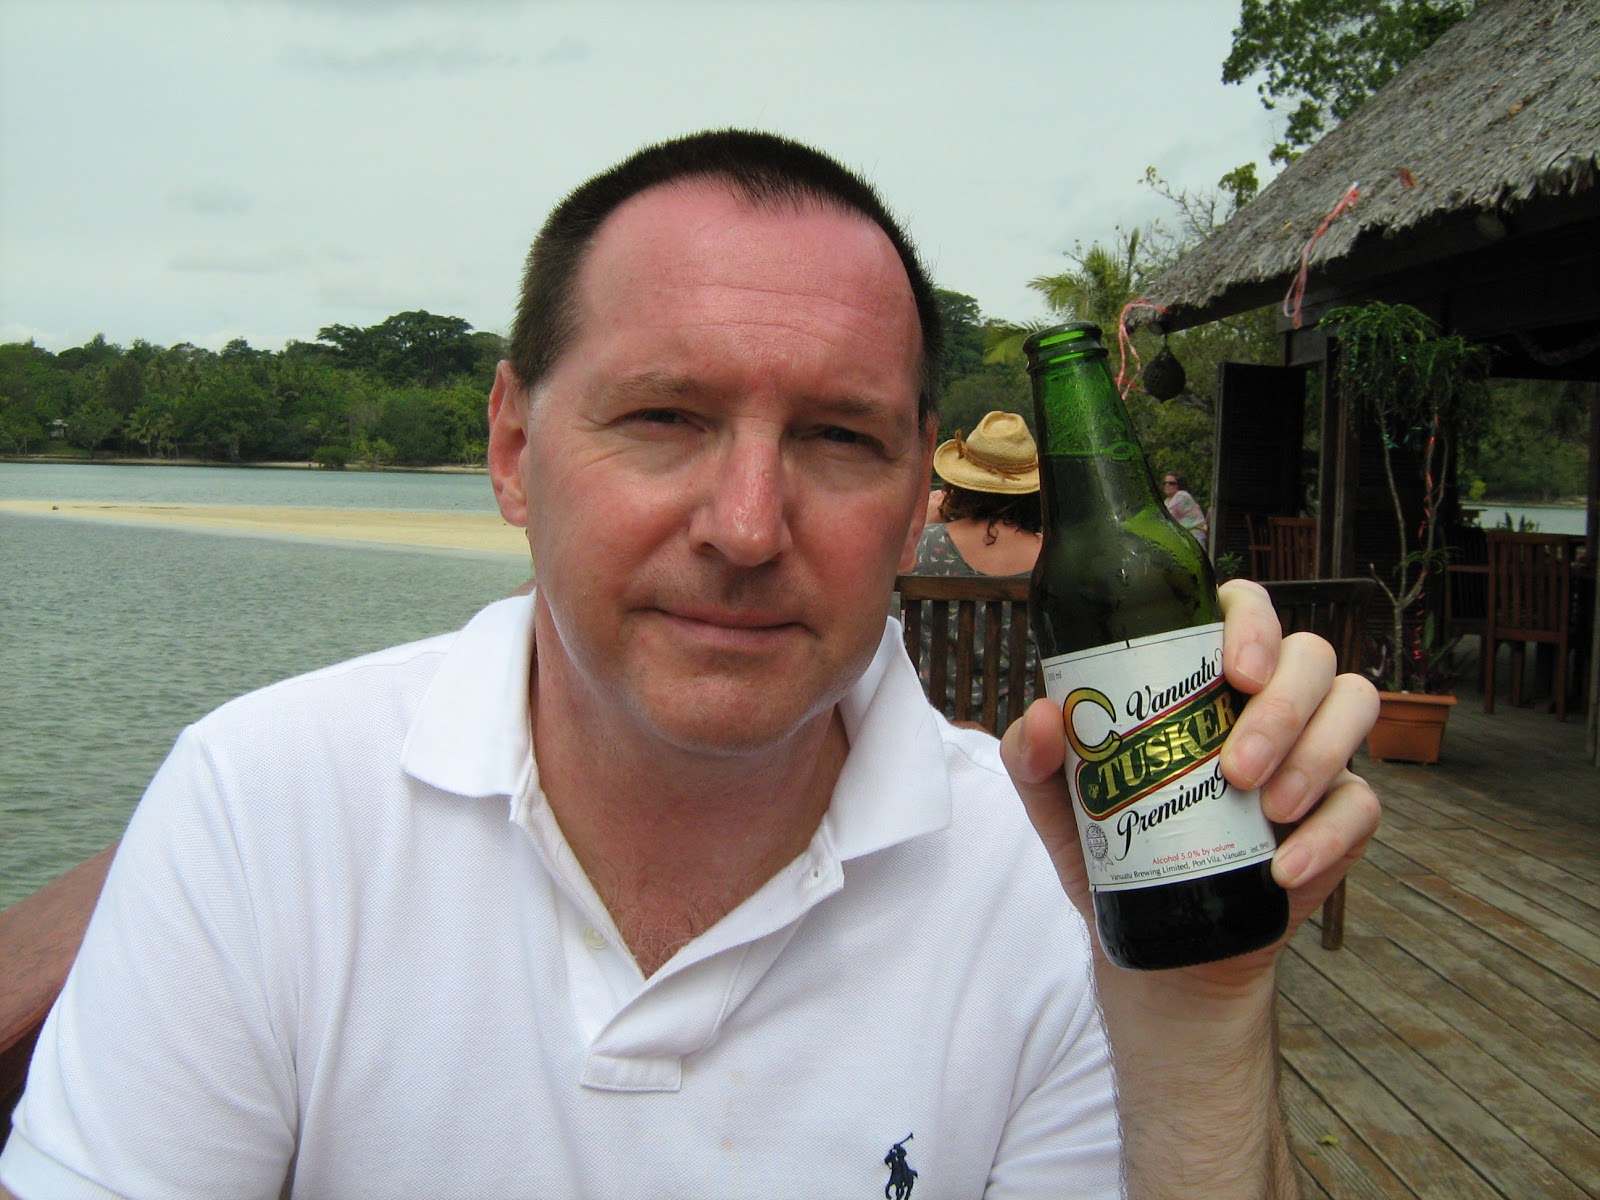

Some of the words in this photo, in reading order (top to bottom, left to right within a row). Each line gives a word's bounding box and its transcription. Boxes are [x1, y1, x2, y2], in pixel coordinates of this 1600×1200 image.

[1126, 648, 1223, 721] Vanuatu
[1098, 692, 1236, 800] TUSKER
[1114, 760, 1228, 861] Premium
[1110, 873, 1133, 881] Vanuatu
[1134, 868, 1161, 877] Brewing
[1162, 861, 1191, 874] Limited,
[1192, 859, 1206, 868] Port
[1222, 850, 1247, 860] Vanuatu
[1152, 853, 1180, 865] Alcohol
[1181, 850, 1200, 860] 5.0%
[1202, 848, 1211, 856] by
[1212, 843, 1235, 853] volume
